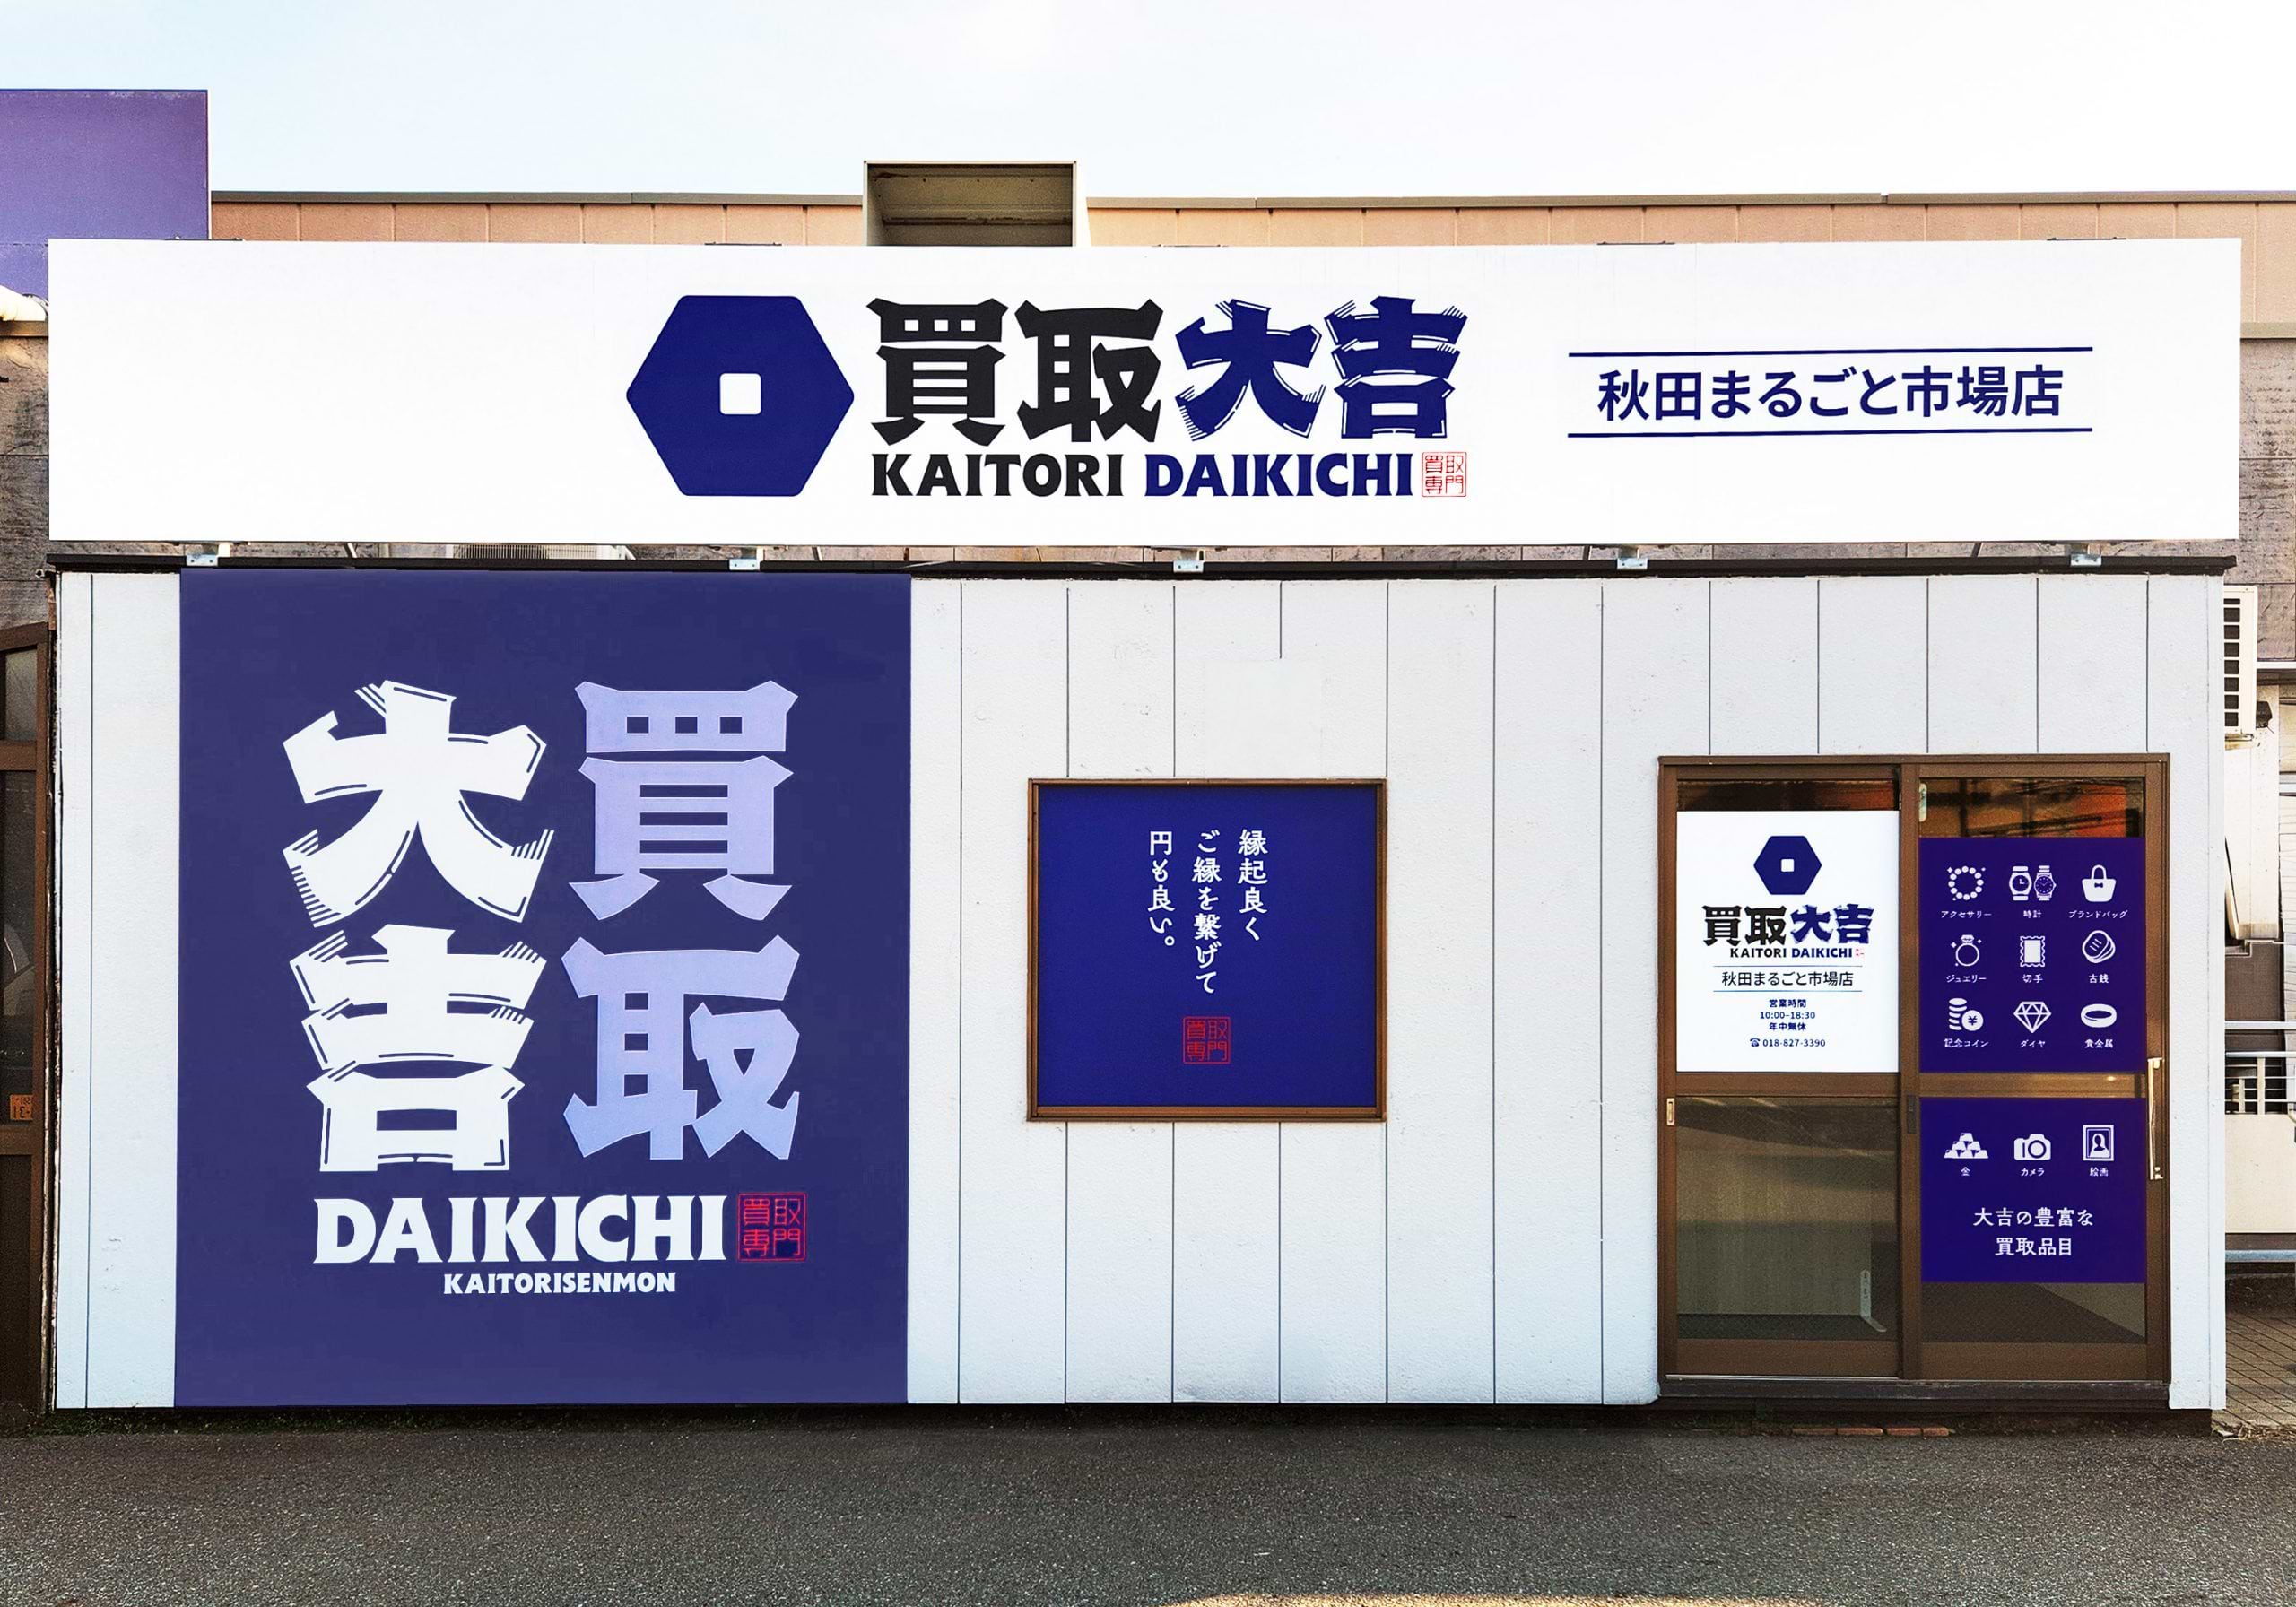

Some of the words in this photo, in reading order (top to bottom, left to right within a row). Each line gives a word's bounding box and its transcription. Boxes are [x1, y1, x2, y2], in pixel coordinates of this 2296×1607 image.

[866, 296, 1467, 447] 買取大吉
[1597, 364, 2063, 421] 秋田まるごと市場店
[872, 453, 1123, 497] KAITORI
[1144, 453, 1413, 497] DAIKICHI
[1148, 831, 1175, 945] 円も良い。
[1238, 830, 1268, 940] 縁起良く
[1192, 830, 1222, 993] ご縁を繋げて
[1941, 910, 1992, 919] アクセサリー
[2022, 909, 2042, 919] 時計
[2068, 909, 2128, 919] ブランドバッグ
[283, 680, 554, 1172] 大吉
[561, 681, 800, 1160] 買取
[1702, 904, 1874, 946] 買取大吉
[1730, 948, 1787, 958] KAITORI
[1792, 948, 1852, 958] DAIKICHI
[1721, 970, 1854, 986] 秋田まるごと市場店
[1945, 974, 1987, 984] ジュエリー
[2022, 973, 2044, 984] 切手
[2088, 973, 2109, 984] 古銭
[1769, 998, 1807, 1009] 営業時間
[1769, 1021, 1807, 1031] 年中無休
[1762, 1038, 1826, 1047] 018-827-3390
[1944, 1038, 1989, 1048] 記念コイン
[2020, 1038, 2046, 1048] ダイヤ
[2084, 1038, 2114, 1049] 貴金属
[1960, 1166, 1971, 1177] 金
[2021, 1167, 2045, 1177] カメラ
[2089, 1166, 2109, 1177] 絵画
[1973, 1207, 2092, 1227] 大吉の豊富な
[313, 1194, 727, 1264] DAIKICHI
[1996, 1238, 2071, 1255] 買取品目
[444, 1272, 676, 1294] KAITORISENMON
